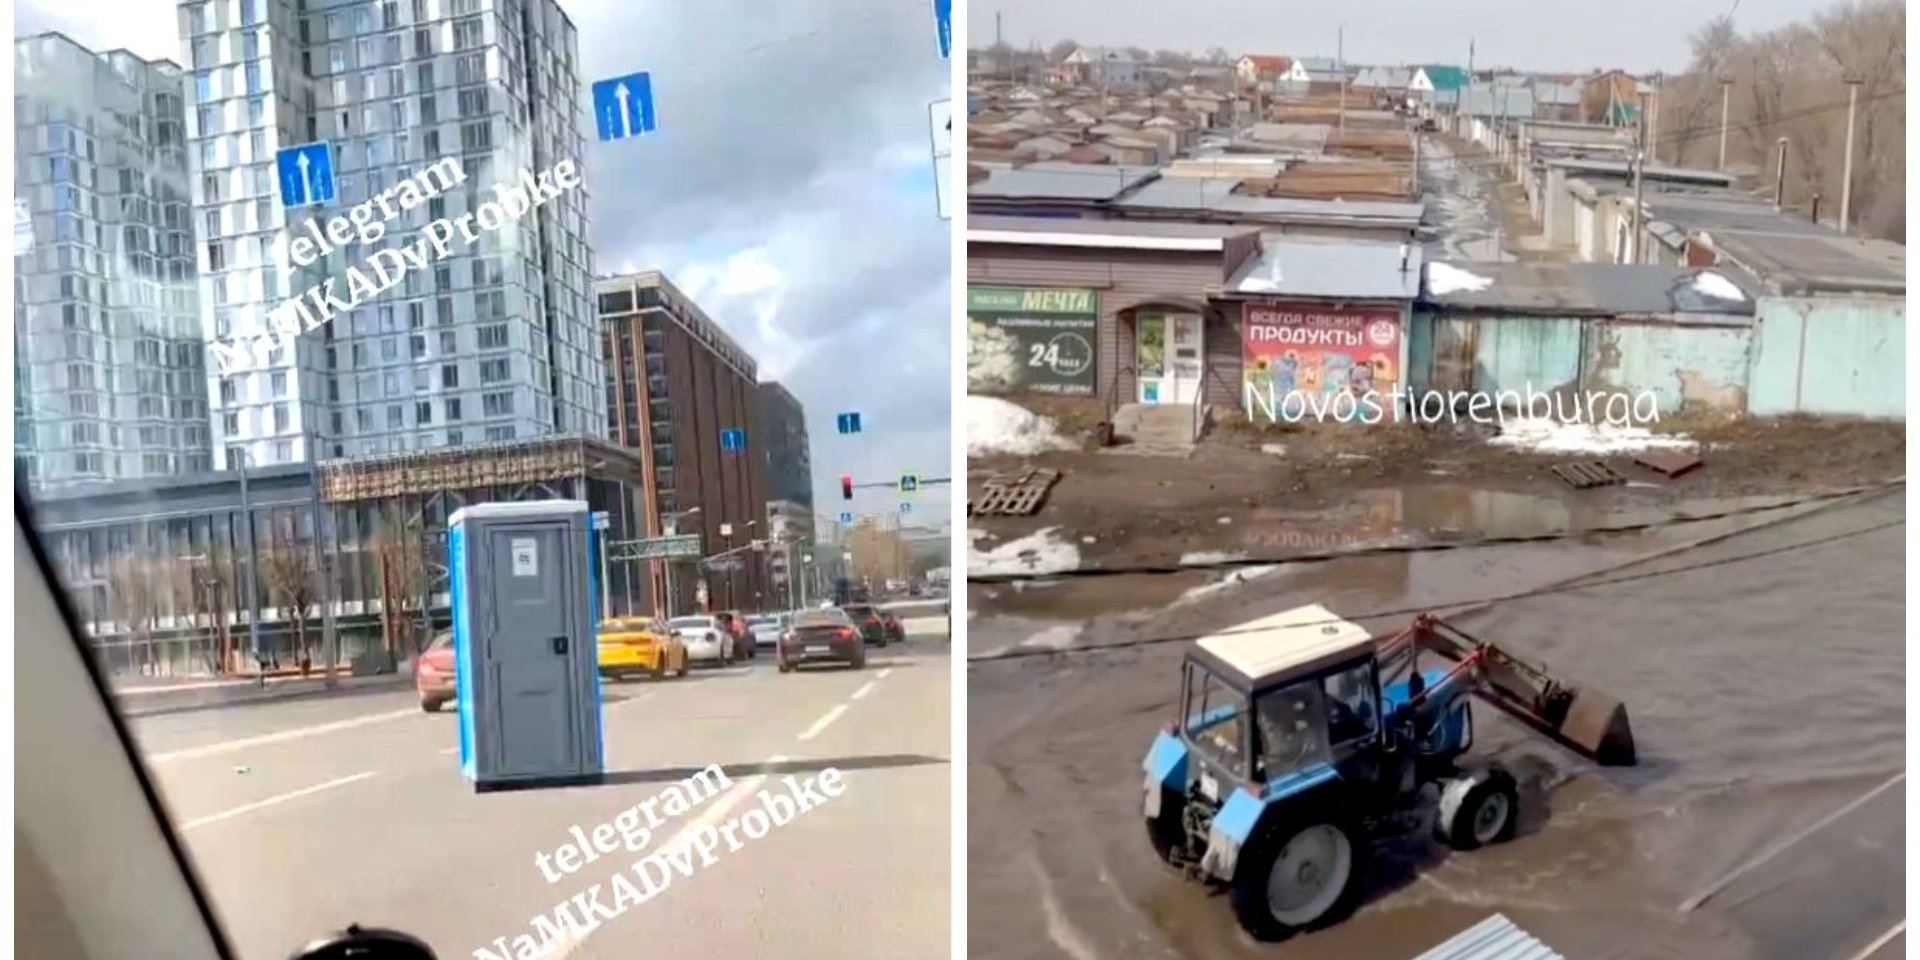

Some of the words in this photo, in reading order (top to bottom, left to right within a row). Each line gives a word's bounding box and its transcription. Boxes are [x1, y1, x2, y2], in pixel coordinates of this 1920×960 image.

[1022, 290, 1091, 312] МЕЧТА
[1251, 311, 1301, 324] ВСЕГДА
[1306, 314, 1364, 327] СВЕЖИЕ
[1250, 325, 1364, 346] ПРОДУКТЫ
[1028, 343, 1060, 367] 24
